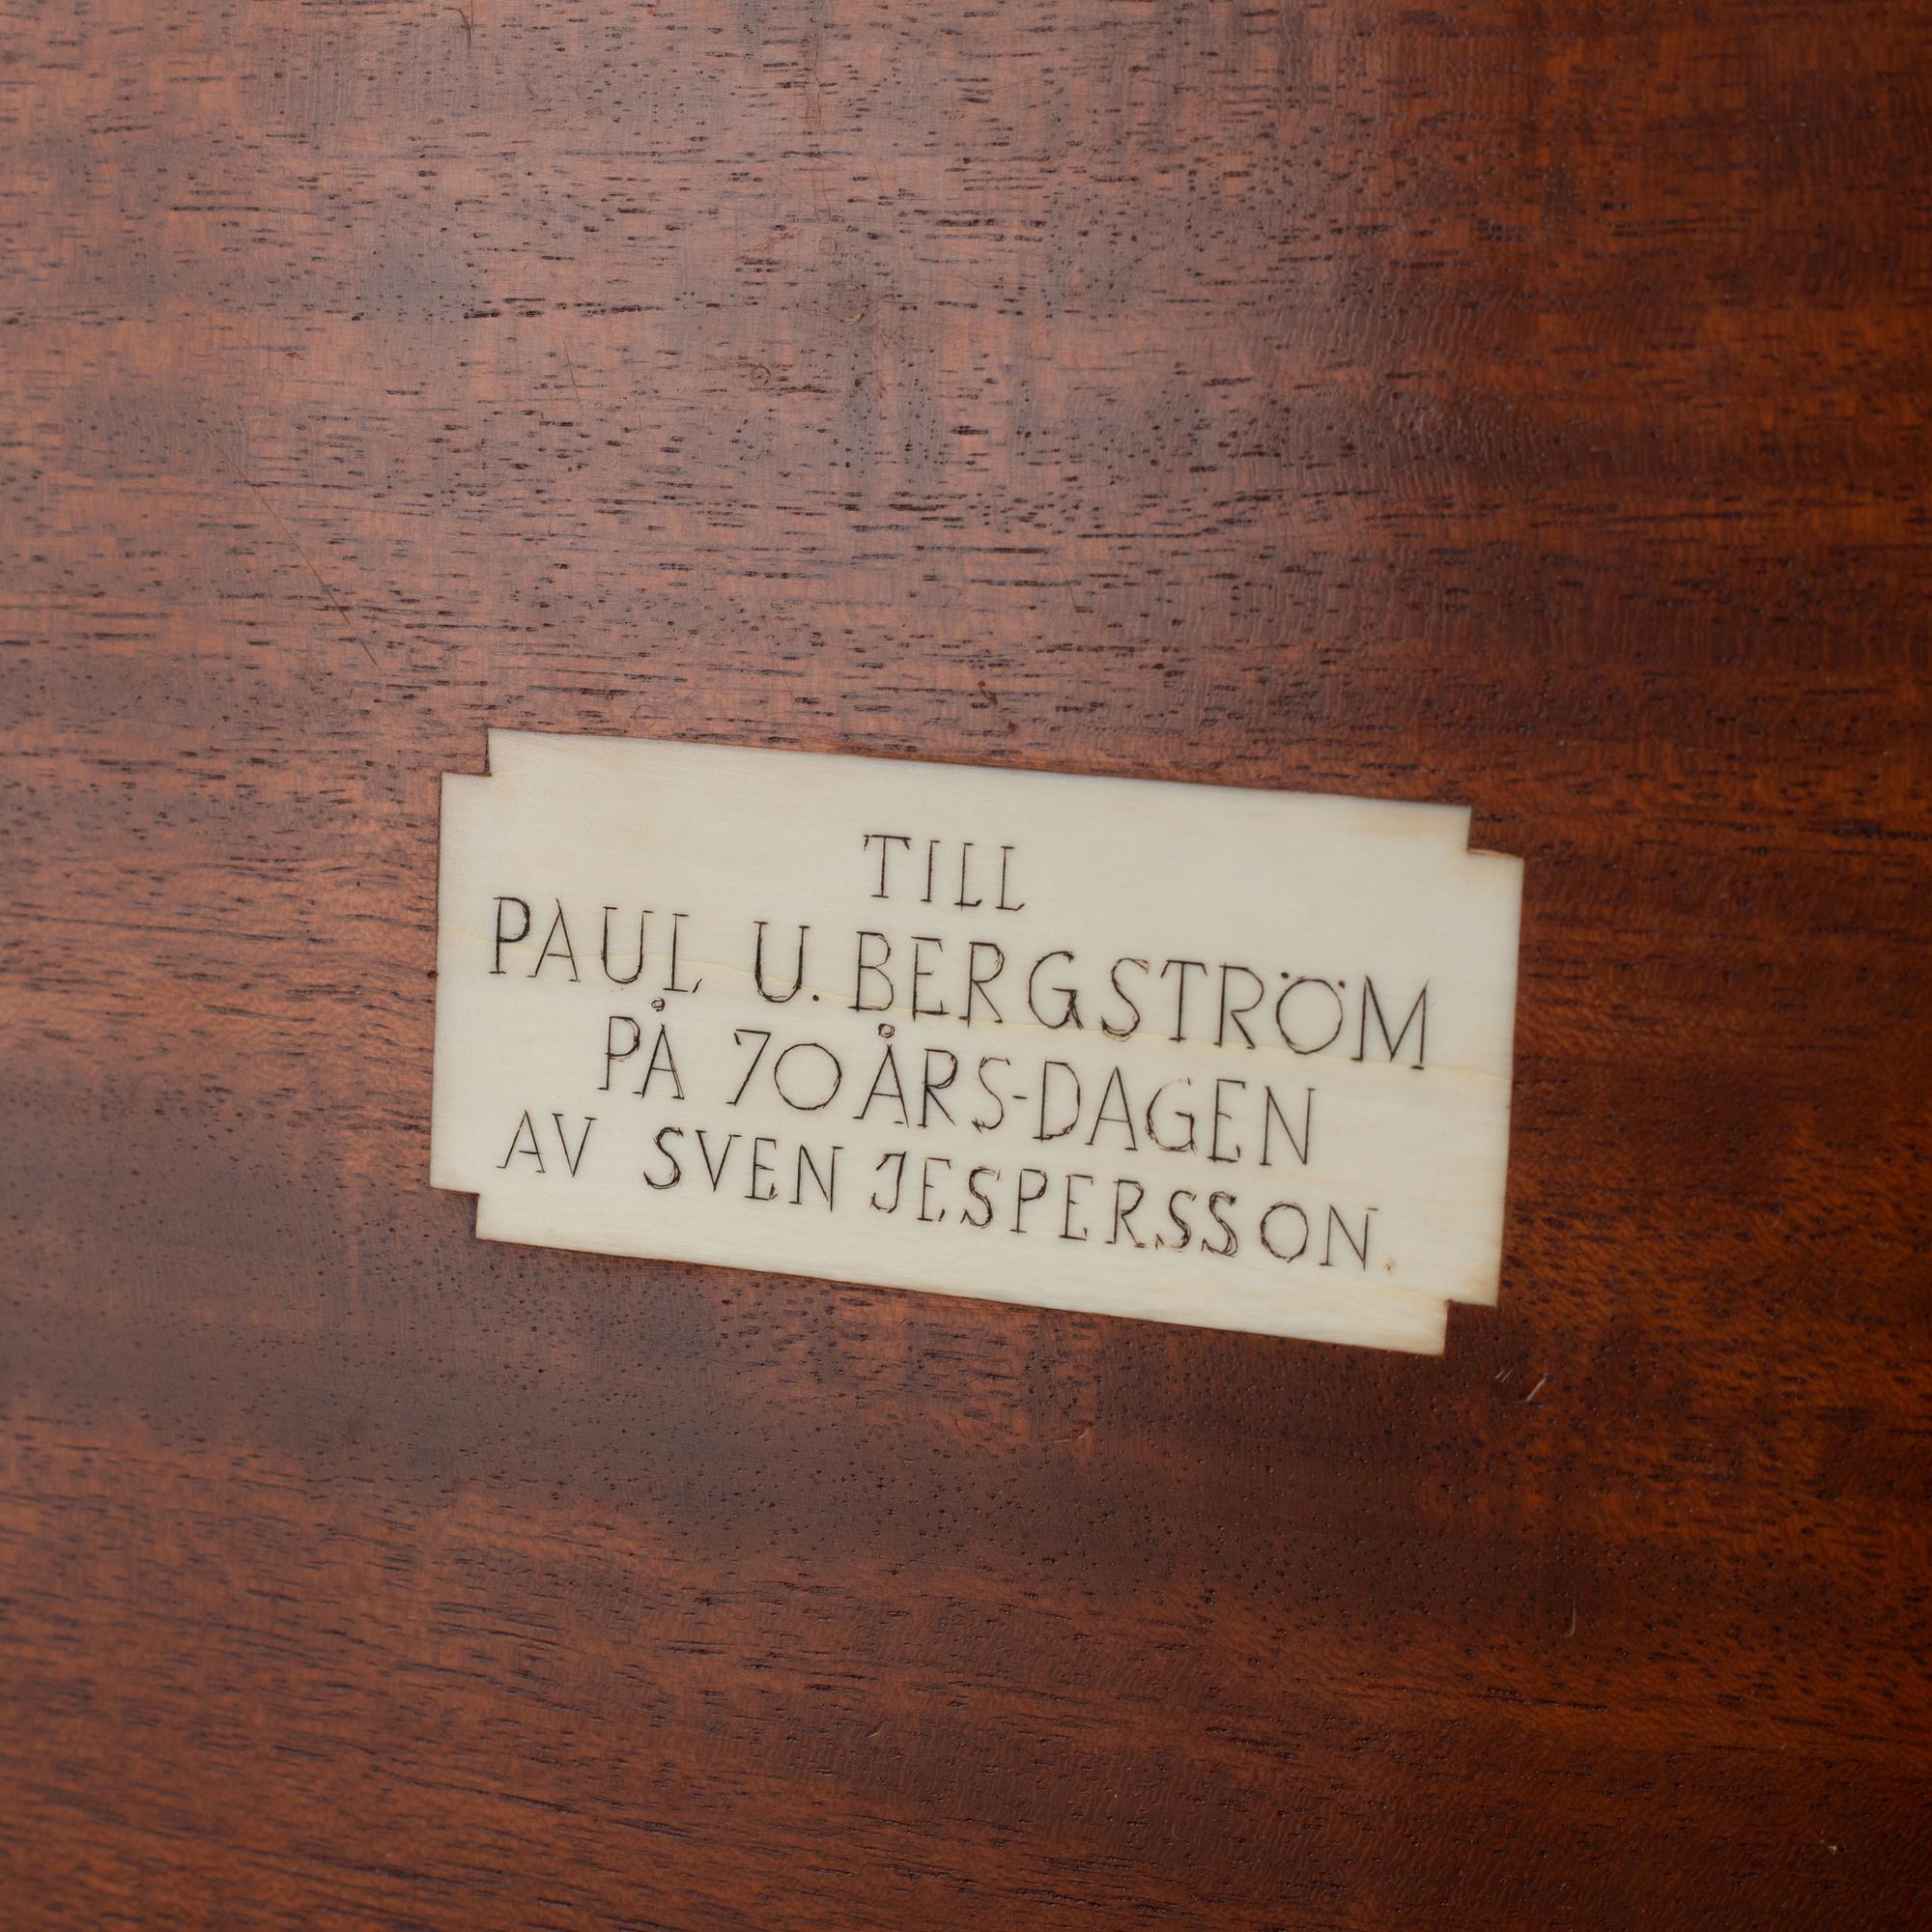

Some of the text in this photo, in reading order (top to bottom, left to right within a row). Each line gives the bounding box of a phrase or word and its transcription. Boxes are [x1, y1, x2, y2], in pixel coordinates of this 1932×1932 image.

[862, 833, 1026, 913] TILL
[488, 895, 703, 993] PAUL
[596, 996, 686, 1101] PÅ
[495, 1108, 598, 1179] AV
[642, 1125, 845, 1213] SVEN
